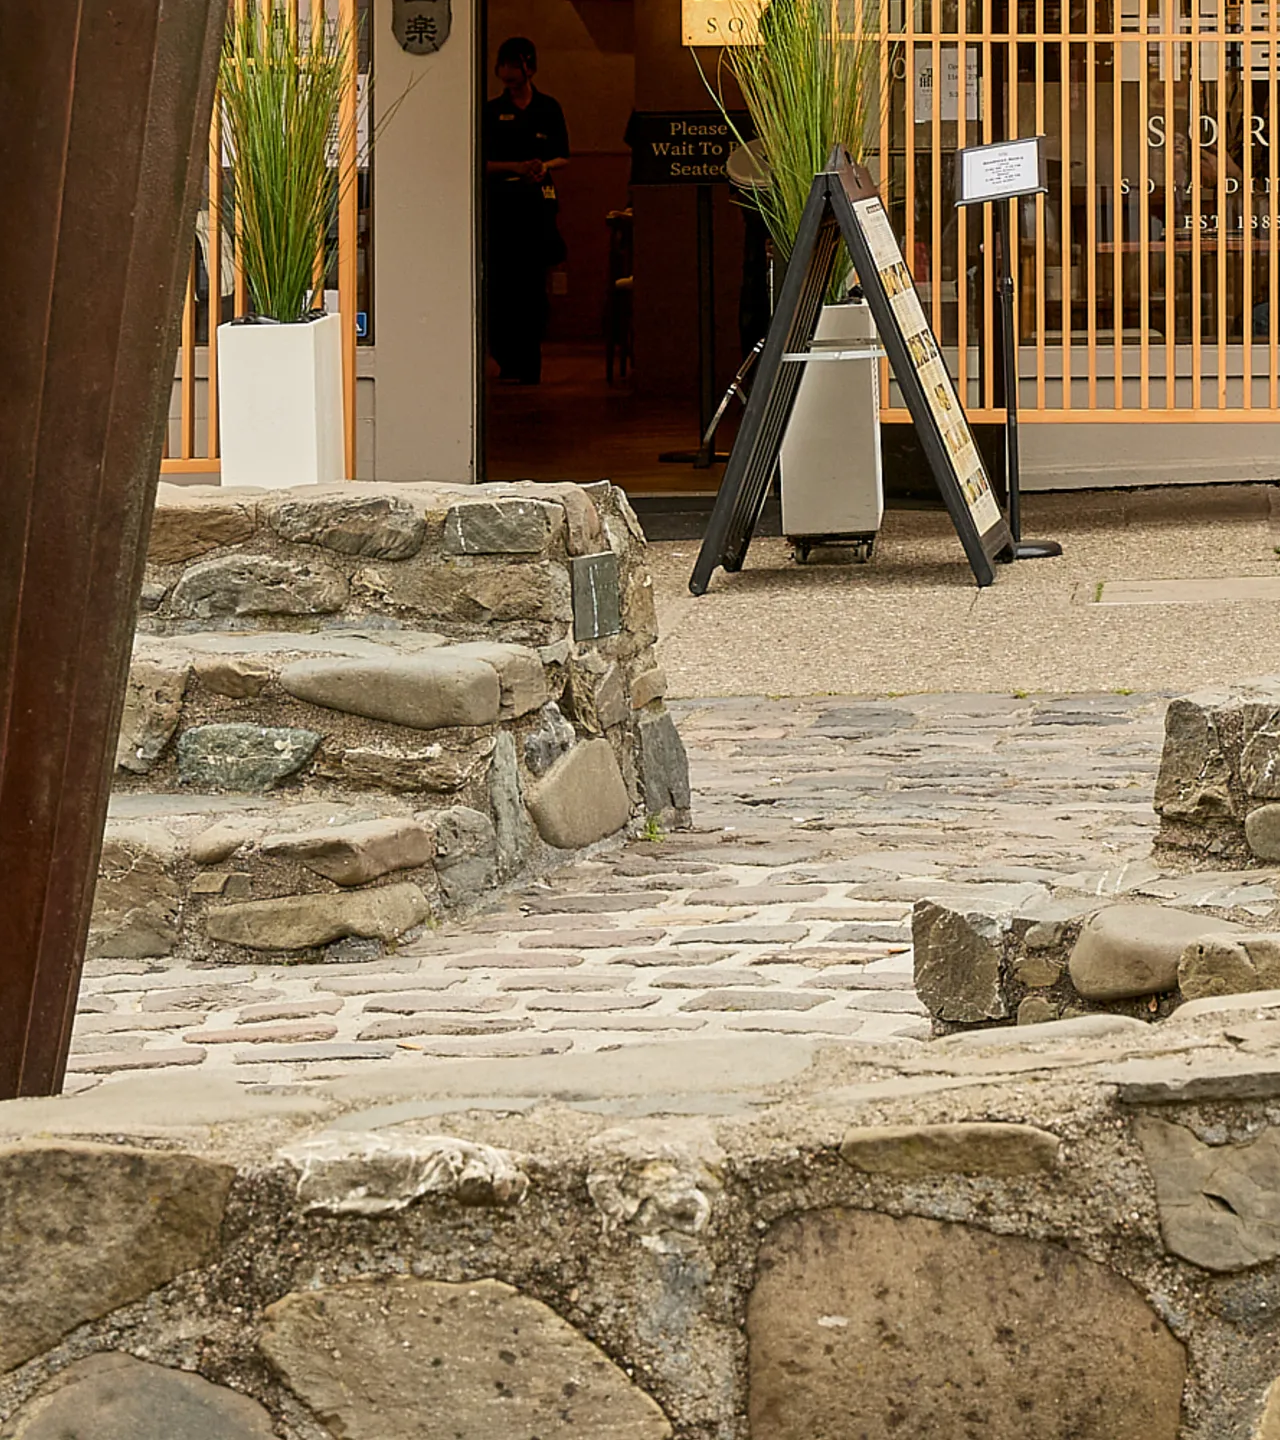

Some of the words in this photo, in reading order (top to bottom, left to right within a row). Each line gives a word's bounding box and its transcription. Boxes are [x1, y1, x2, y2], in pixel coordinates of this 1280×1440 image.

[670, 121, 728, 136] Please
[651, 142, 695, 156] Wait
[698, 142, 723, 156] To
